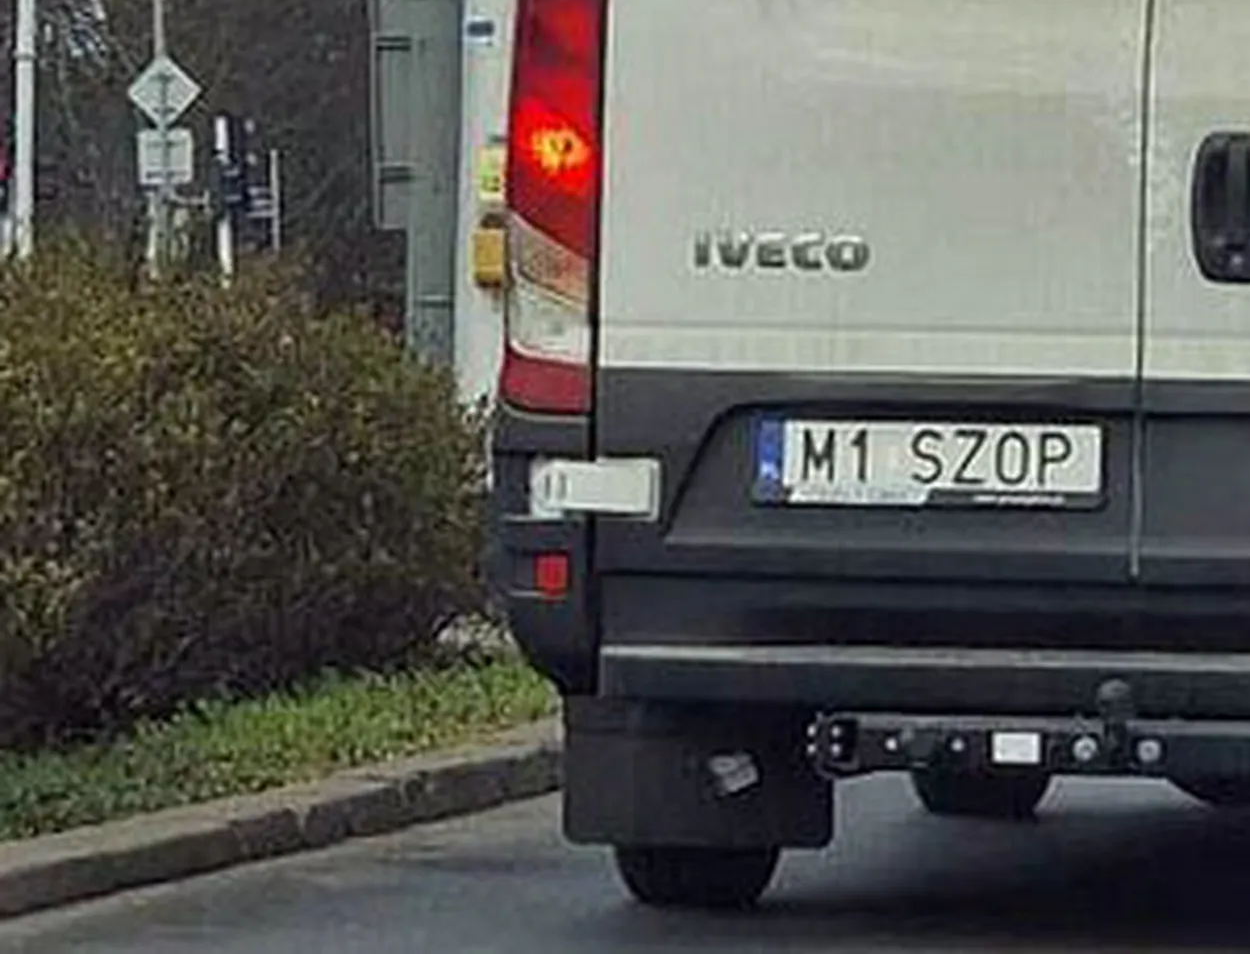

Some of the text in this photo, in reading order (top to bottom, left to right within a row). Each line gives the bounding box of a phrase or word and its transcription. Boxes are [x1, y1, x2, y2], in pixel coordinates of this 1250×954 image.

[693, 231, 870, 271] IVECO
[802, 428, 1073, 486] M1 SZOP
